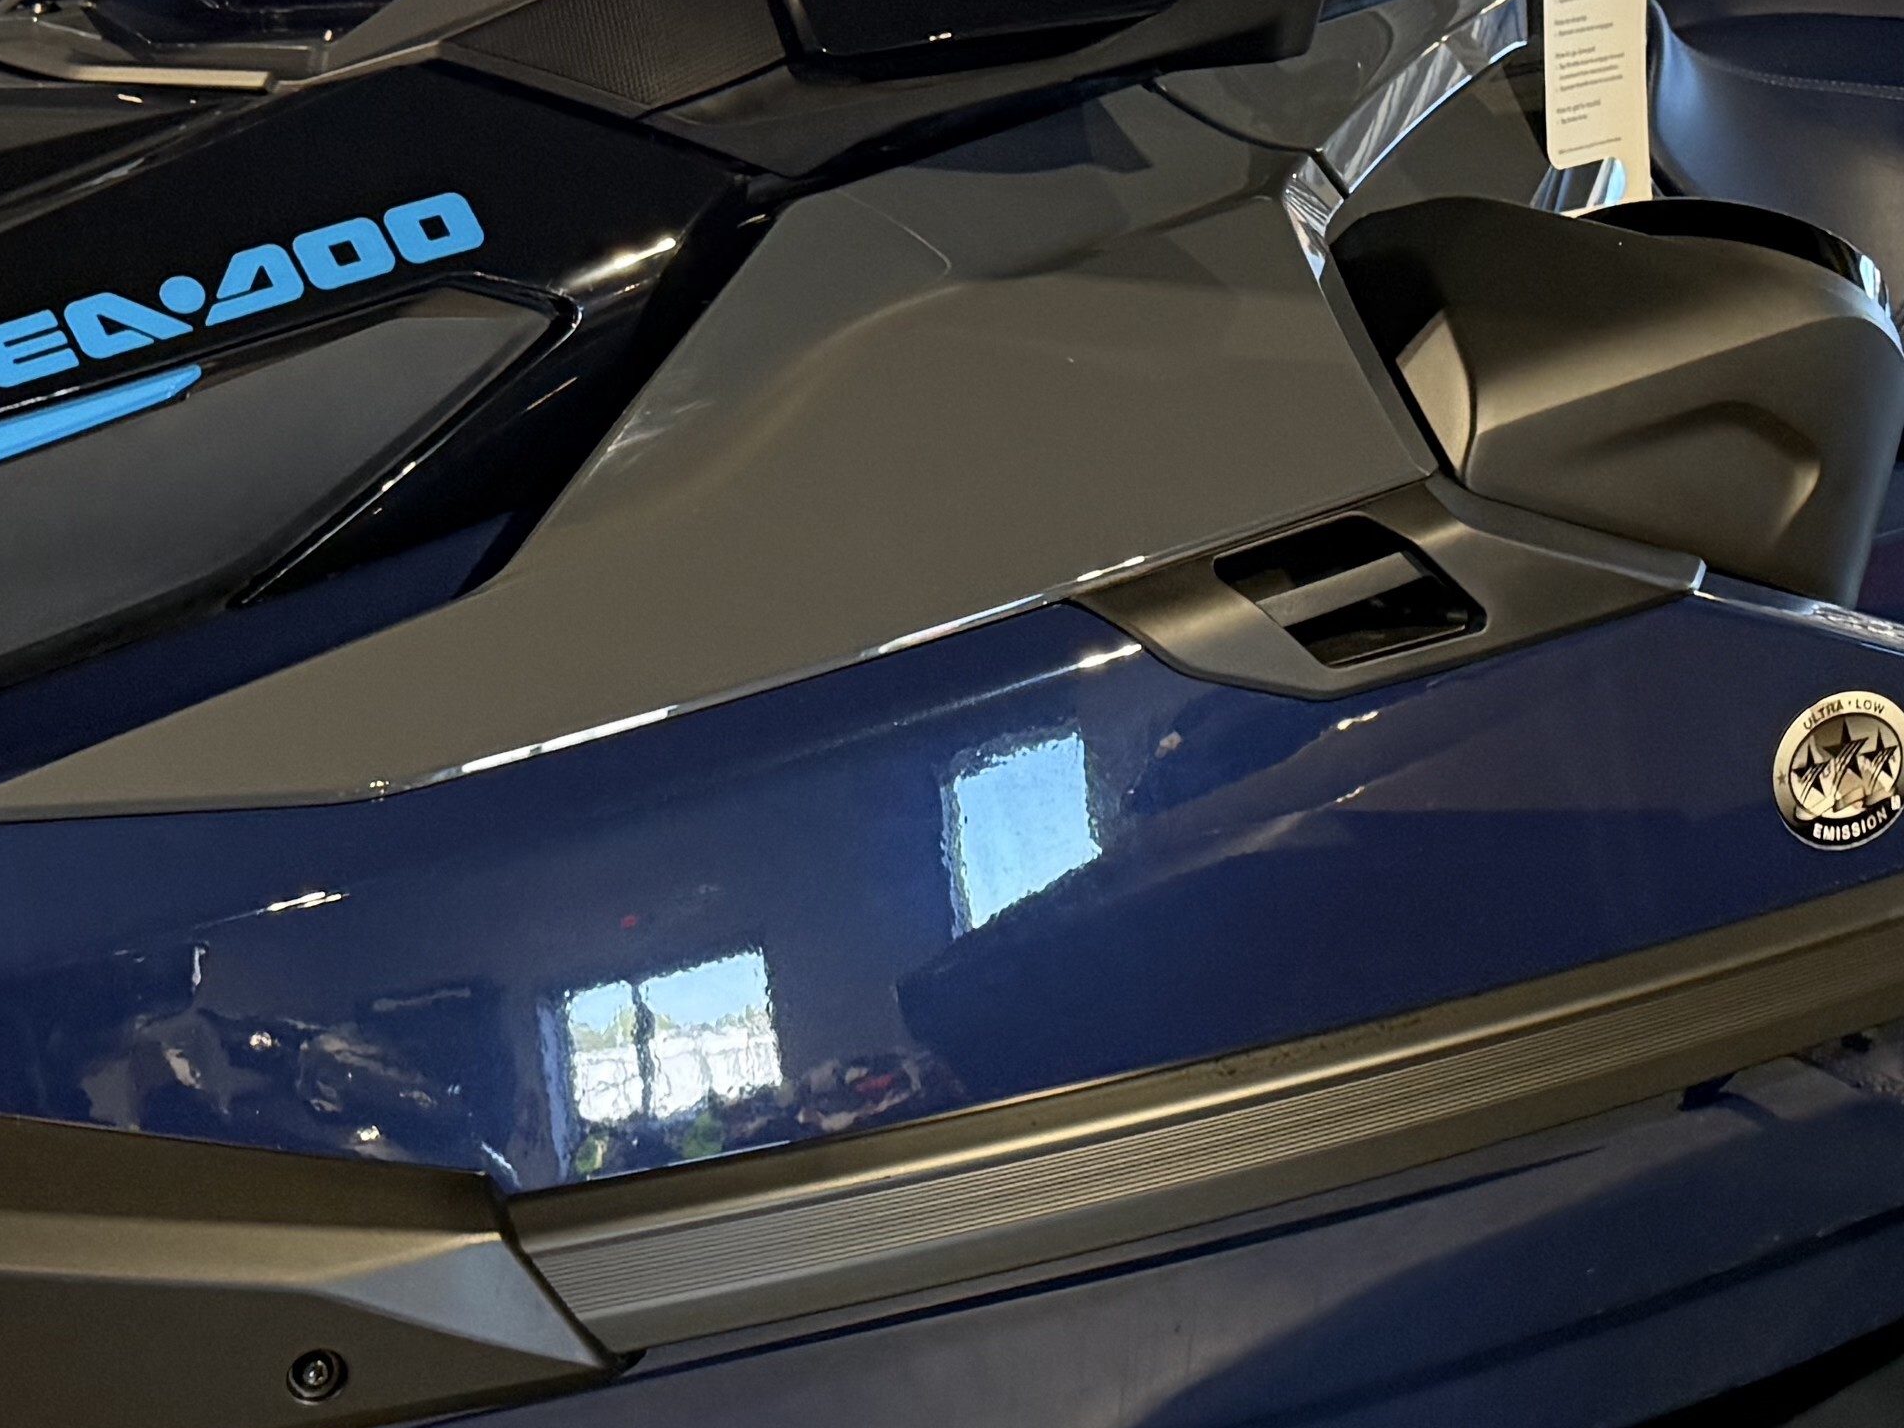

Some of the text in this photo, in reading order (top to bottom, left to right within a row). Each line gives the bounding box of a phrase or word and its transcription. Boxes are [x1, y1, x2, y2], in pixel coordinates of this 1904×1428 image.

[1803, 697, 1885, 731] ULTRA LOW
[1812, 806, 1888, 842] EMISSION
